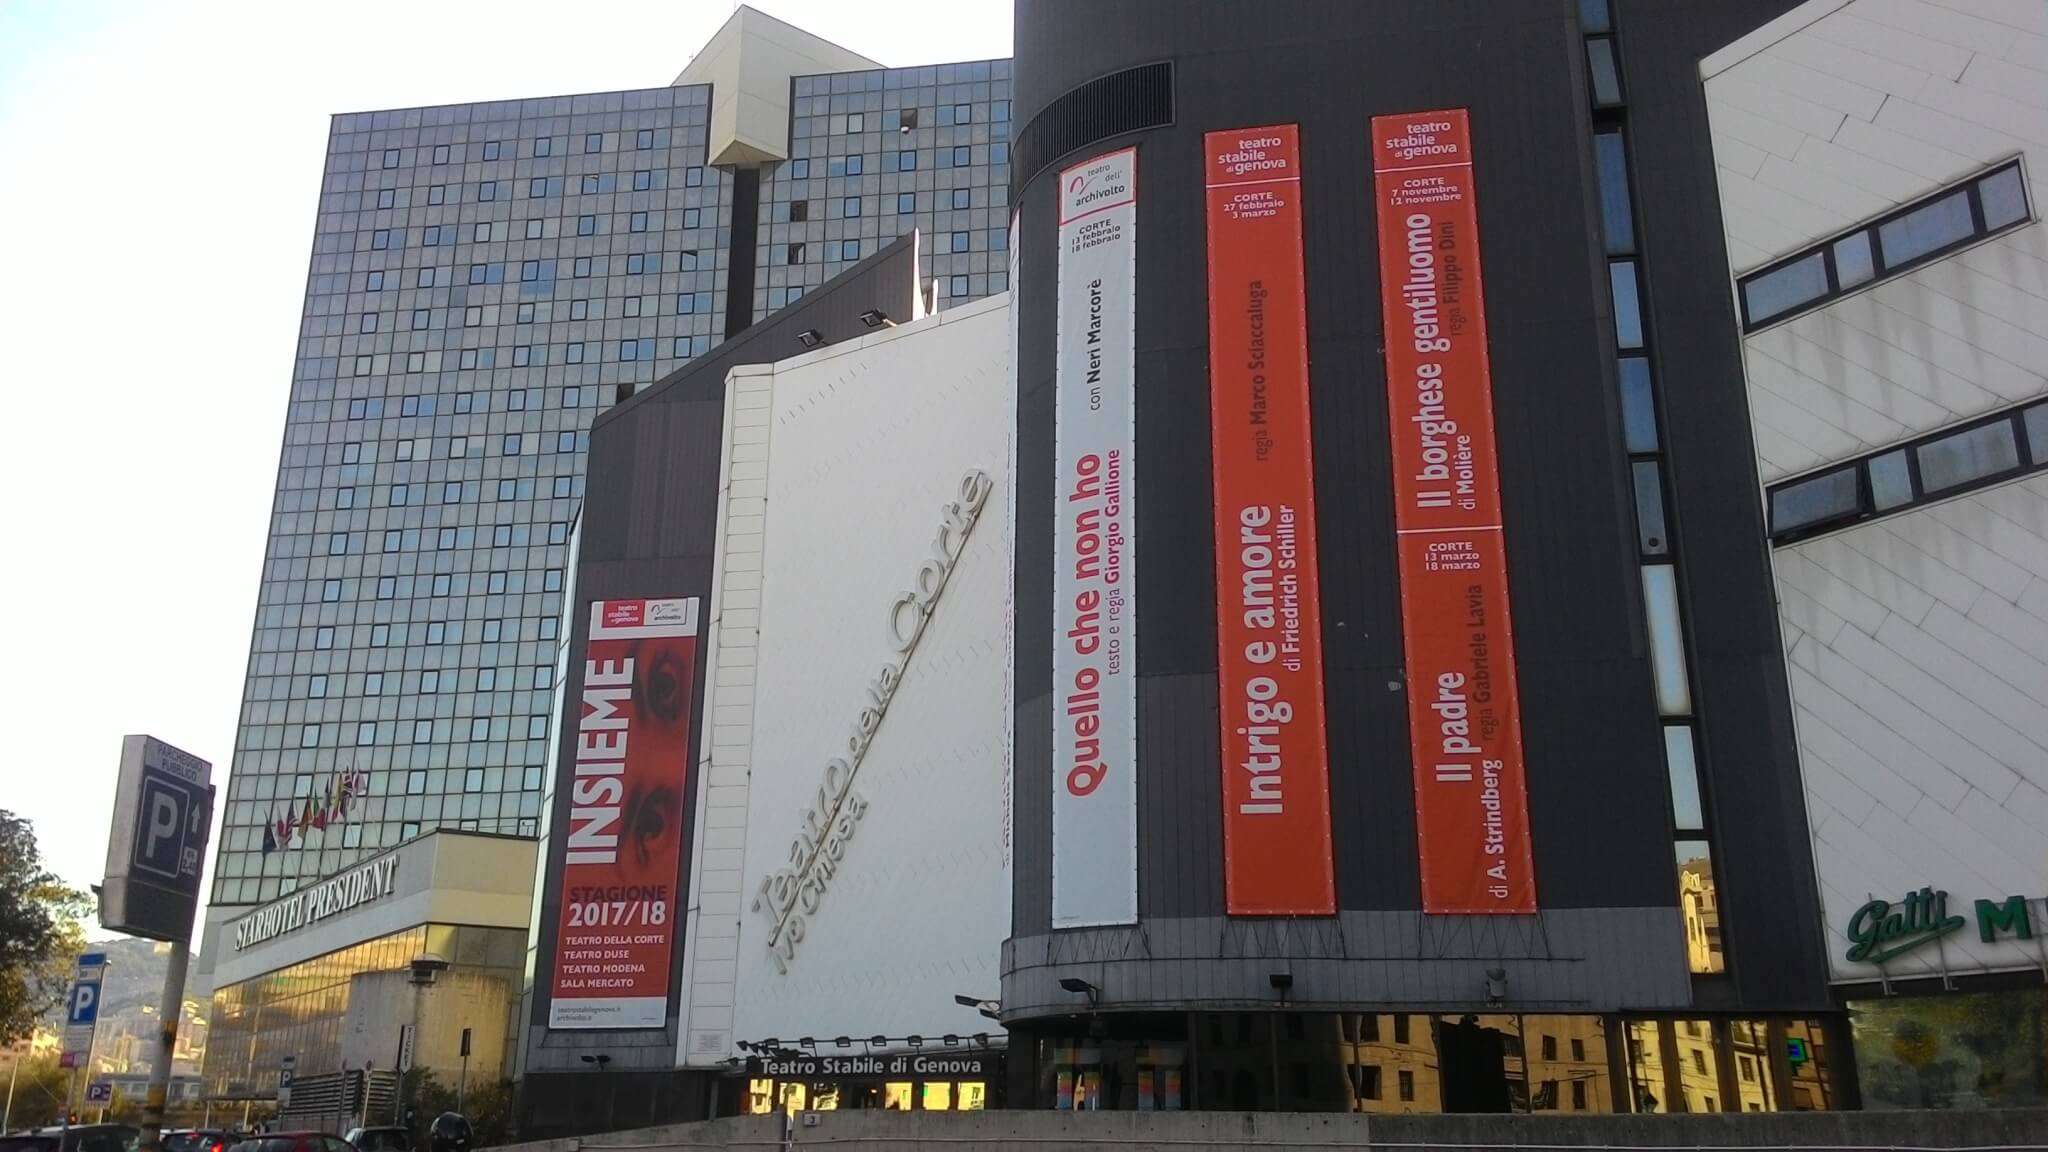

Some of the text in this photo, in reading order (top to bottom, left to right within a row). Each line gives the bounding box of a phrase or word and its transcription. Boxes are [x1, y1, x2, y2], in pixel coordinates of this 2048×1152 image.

[1406, 121, 1451, 134] teatro
[1238, 137, 1282, 149] teatro
[1385, 134, 1436, 149] stabile
[1218, 149, 1266, 164] stabile
[1403, 143, 1457, 160] genova
[1087, 164, 1111, 177] teatro
[1234, 159, 1287, 175] genova
[1403, 176, 1445, 188] CORTE
[1075, 184, 1126, 207] archivolto
[1233, 191, 1273, 203] CORTE
[1390, 193, 1463, 206] 12 novembre
[1391, 185, 1458, 197] 7 novembre
[1223, 199, 1285, 212] 27 febbraio
[1232, 208, 1277, 219] 3 marzo
[1079, 218, 1112, 235] CORTE
[1082, 225, 1121, 241] febbraio
[1082, 233, 1121, 249] febbraio
[1086, 277, 1102, 412] con Neri Marcorè
[1402, 213, 1458, 508] Il borghese gentiluomo
[1249, 374, 1267, 425] Marco
[1453, 434, 1476, 510] di Molière
[1428, 541, 1473, 552] CORTE
[1104, 449, 1125, 676] testo e regia Giorgio Gallione
[1424, 552, 1480, 562] 13 marzo
[1425, 562, 1481, 571] 18 marzo
[1276, 504, 1301, 672] di Friedrich Schiller
[1466, 584, 1486, 627] Lavia
[1066, 453, 1108, 797] Quello che non ho
[1236, 505, 1293, 815] Intrigo e amore
[1468, 633, 1492, 704] Gabriele
[752, 757, 851, 946] Teatro
[888, 467, 986, 653] Corte
[1431, 671, 1483, 782] Il padre
[565, 656, 635, 865] INSIEME
[145, 790, 179, 860] P
[1480, 759, 1509, 899] di A. Strindberg
[569, 885, 667, 902] STAGIONE
[234, 854, 398, 952] STARHOTEL PRESIDENT
[567, 901, 666, 927] 2017/18
[1845, 886, 1966, 964] Gatti
[565, 934, 665, 946] TEATRO DELLA CORTE
[564, 950, 630, 960] TEATRO DUSE
[562, 964, 646, 974] TEATRO MODENA
[560, 978, 634, 988] SALA MERCATO
[72, 985, 95, 1021] P
[403, 1026, 413, 1067] TICKET
[760, 1056, 982, 1075] Teatro Stabile di Genova
[282, 1071, 291, 1087] P
